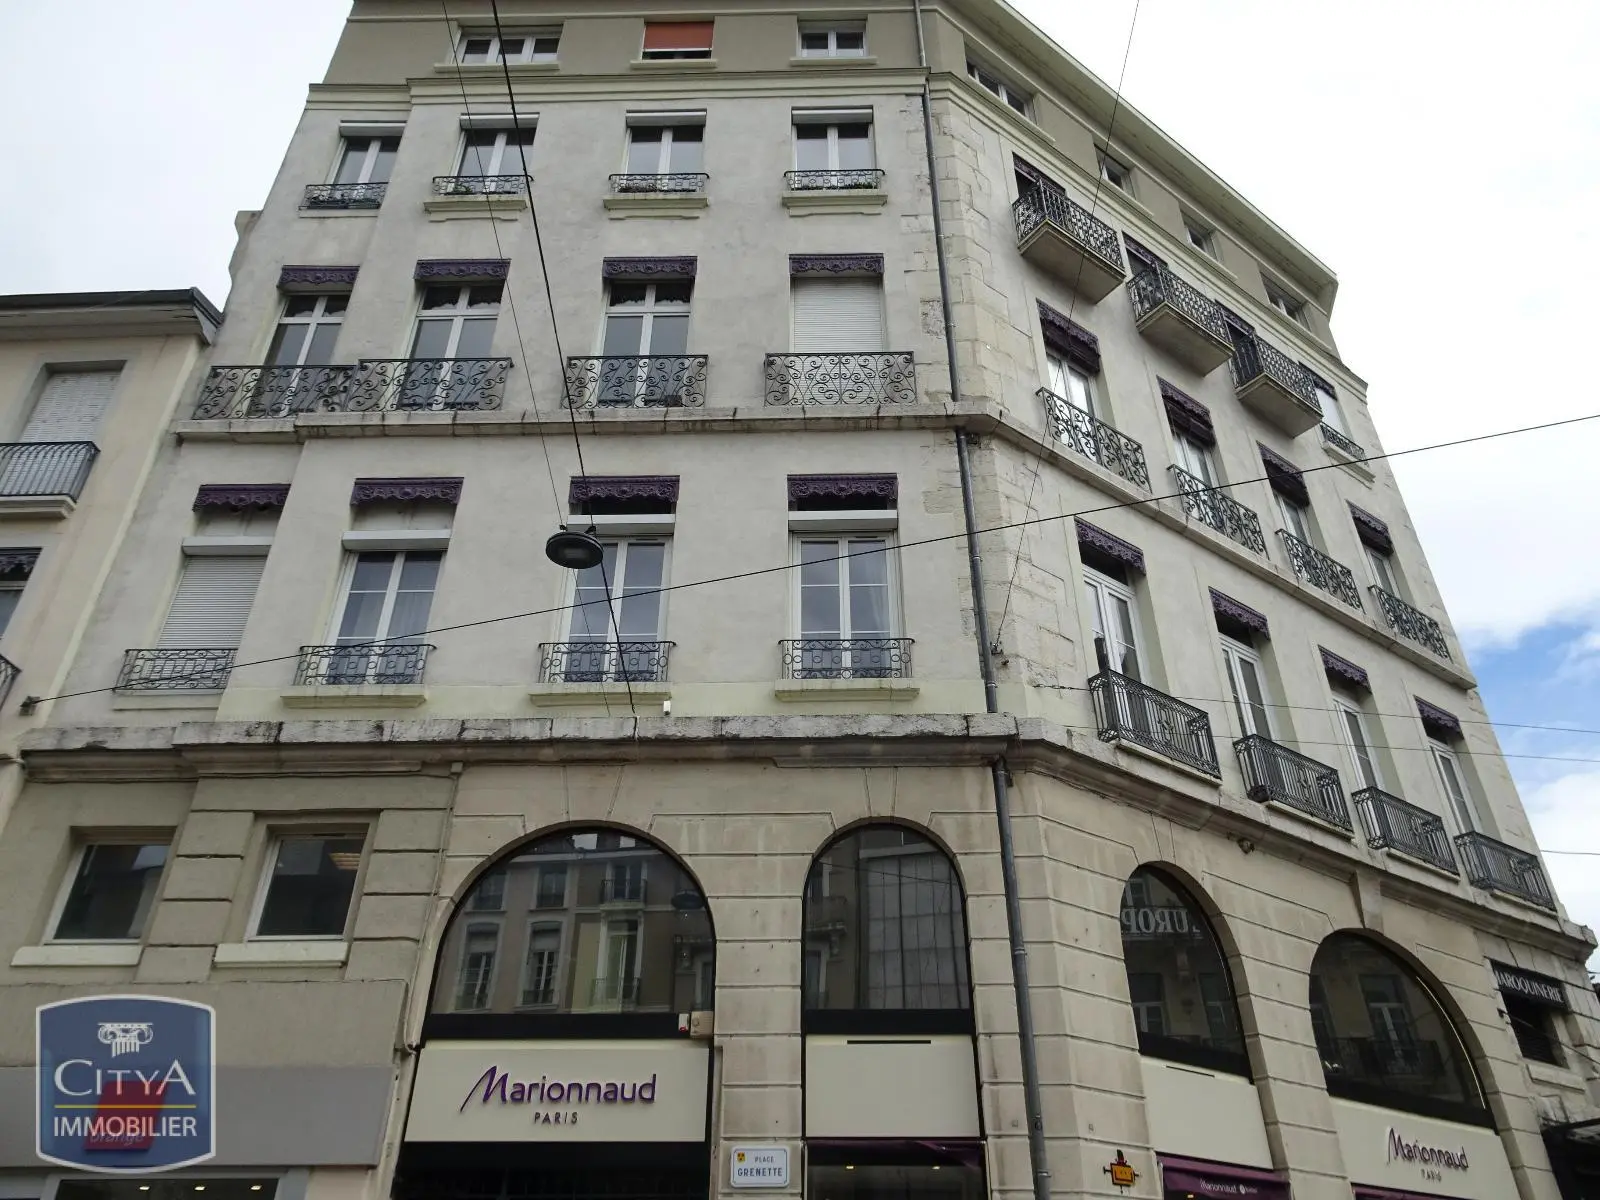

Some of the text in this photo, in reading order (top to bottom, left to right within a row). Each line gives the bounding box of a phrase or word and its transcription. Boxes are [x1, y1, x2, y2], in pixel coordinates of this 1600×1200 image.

[460, 1065, 656, 1112] Marionnaud
[534, 1112, 578, 1125] PARIS
[1388, 1127, 1469, 1170] Marionnaud
[737, 1167, 783, 1177] GRENETTE
